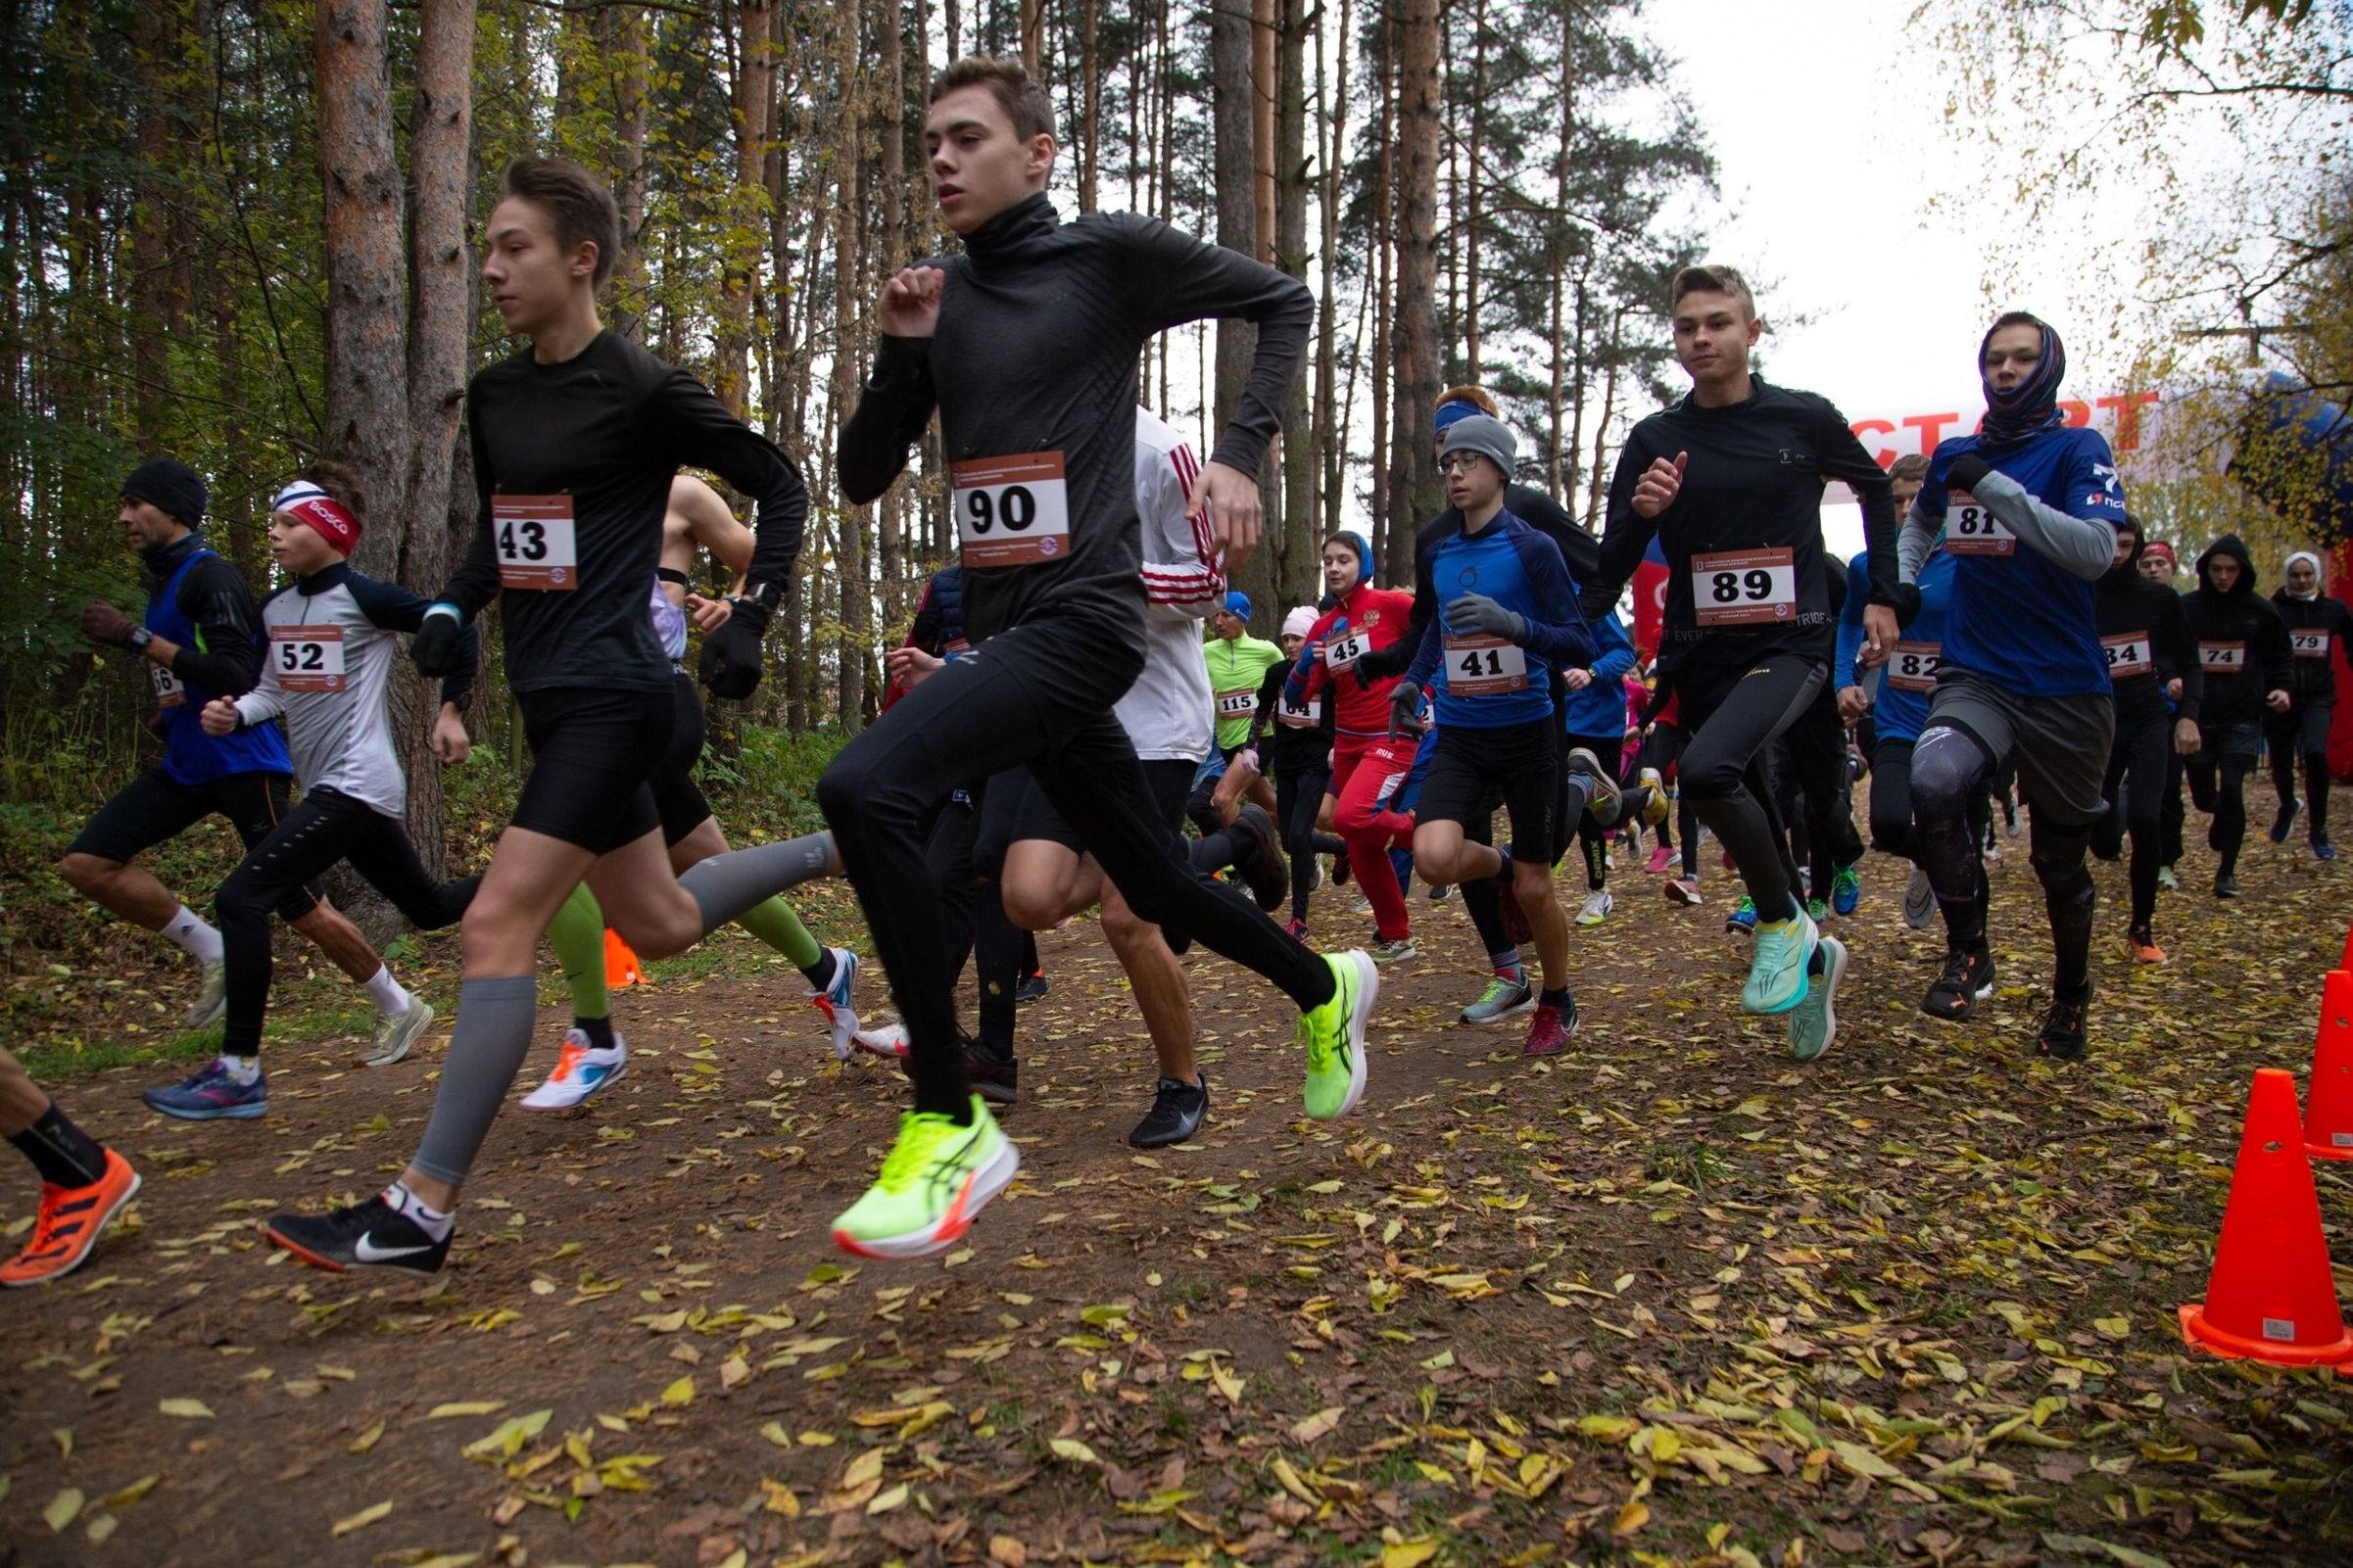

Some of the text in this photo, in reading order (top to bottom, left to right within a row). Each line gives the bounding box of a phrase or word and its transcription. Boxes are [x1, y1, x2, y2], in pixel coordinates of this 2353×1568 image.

[1849, 392, 2160, 470] СТРТ
[2093, 462, 2118, 494] 7
[309, 500, 349, 535] BOSCO
[968, 485, 1035, 535] 90
[1959, 507, 1995, 535] 81
[500, 521, 548, 561] 43
[1712, 569, 1772, 603] 89
[1333, 638, 1360, 661] 45
[2207, 649, 2233, 663] 74
[2294, 636, 2319, 648] 79
[282, 642, 324, 671] 52
[1461, 649, 1504, 677] 41
[1901, 654, 1941, 677] 82
[1223, 695, 1252, 711] 115
[1375, 747, 1395, 760] RUS
